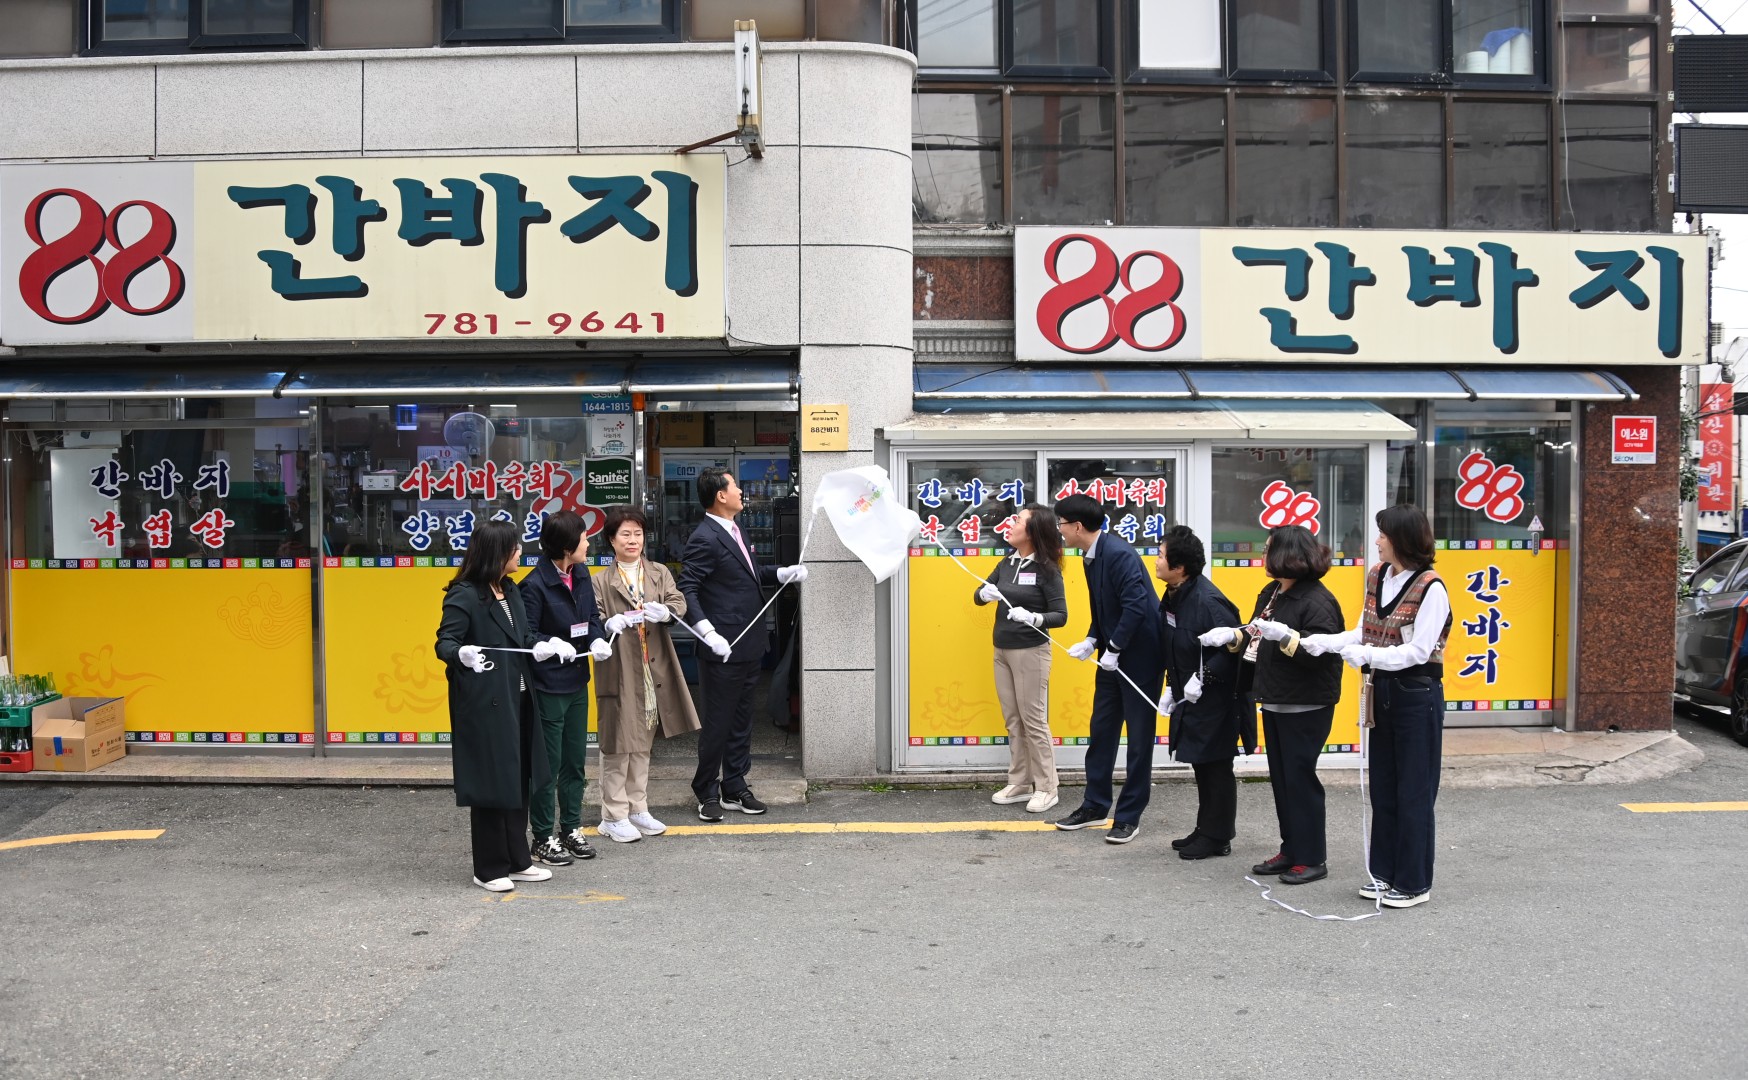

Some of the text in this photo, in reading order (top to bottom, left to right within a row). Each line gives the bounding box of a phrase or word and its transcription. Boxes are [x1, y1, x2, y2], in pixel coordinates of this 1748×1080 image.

[19, 170, 700, 325] 88 간바지
[1036, 233, 1684, 359] 88 간바지
[424, 312, 666, 335] 781-9641
[584, 402, 630, 411] 1644-1815
[810, 426, 840, 434] 88간바지
[1620, 428, 1648, 441] 에스원
[90, 459, 232, 499] 간바지
[401, 460, 553, 501] 사시미육회
[588, 472, 630, 483] Sanitec
[918, 478, 1024, 507] 간바지
[1055, 478, 1168, 507] 사시미육회
[1456, 451, 1525, 524] 88
[90, 508, 234, 549] 낙엽살
[1259, 480, 1321, 537] 88
[1460, 566, 1511, 685] 간바지
